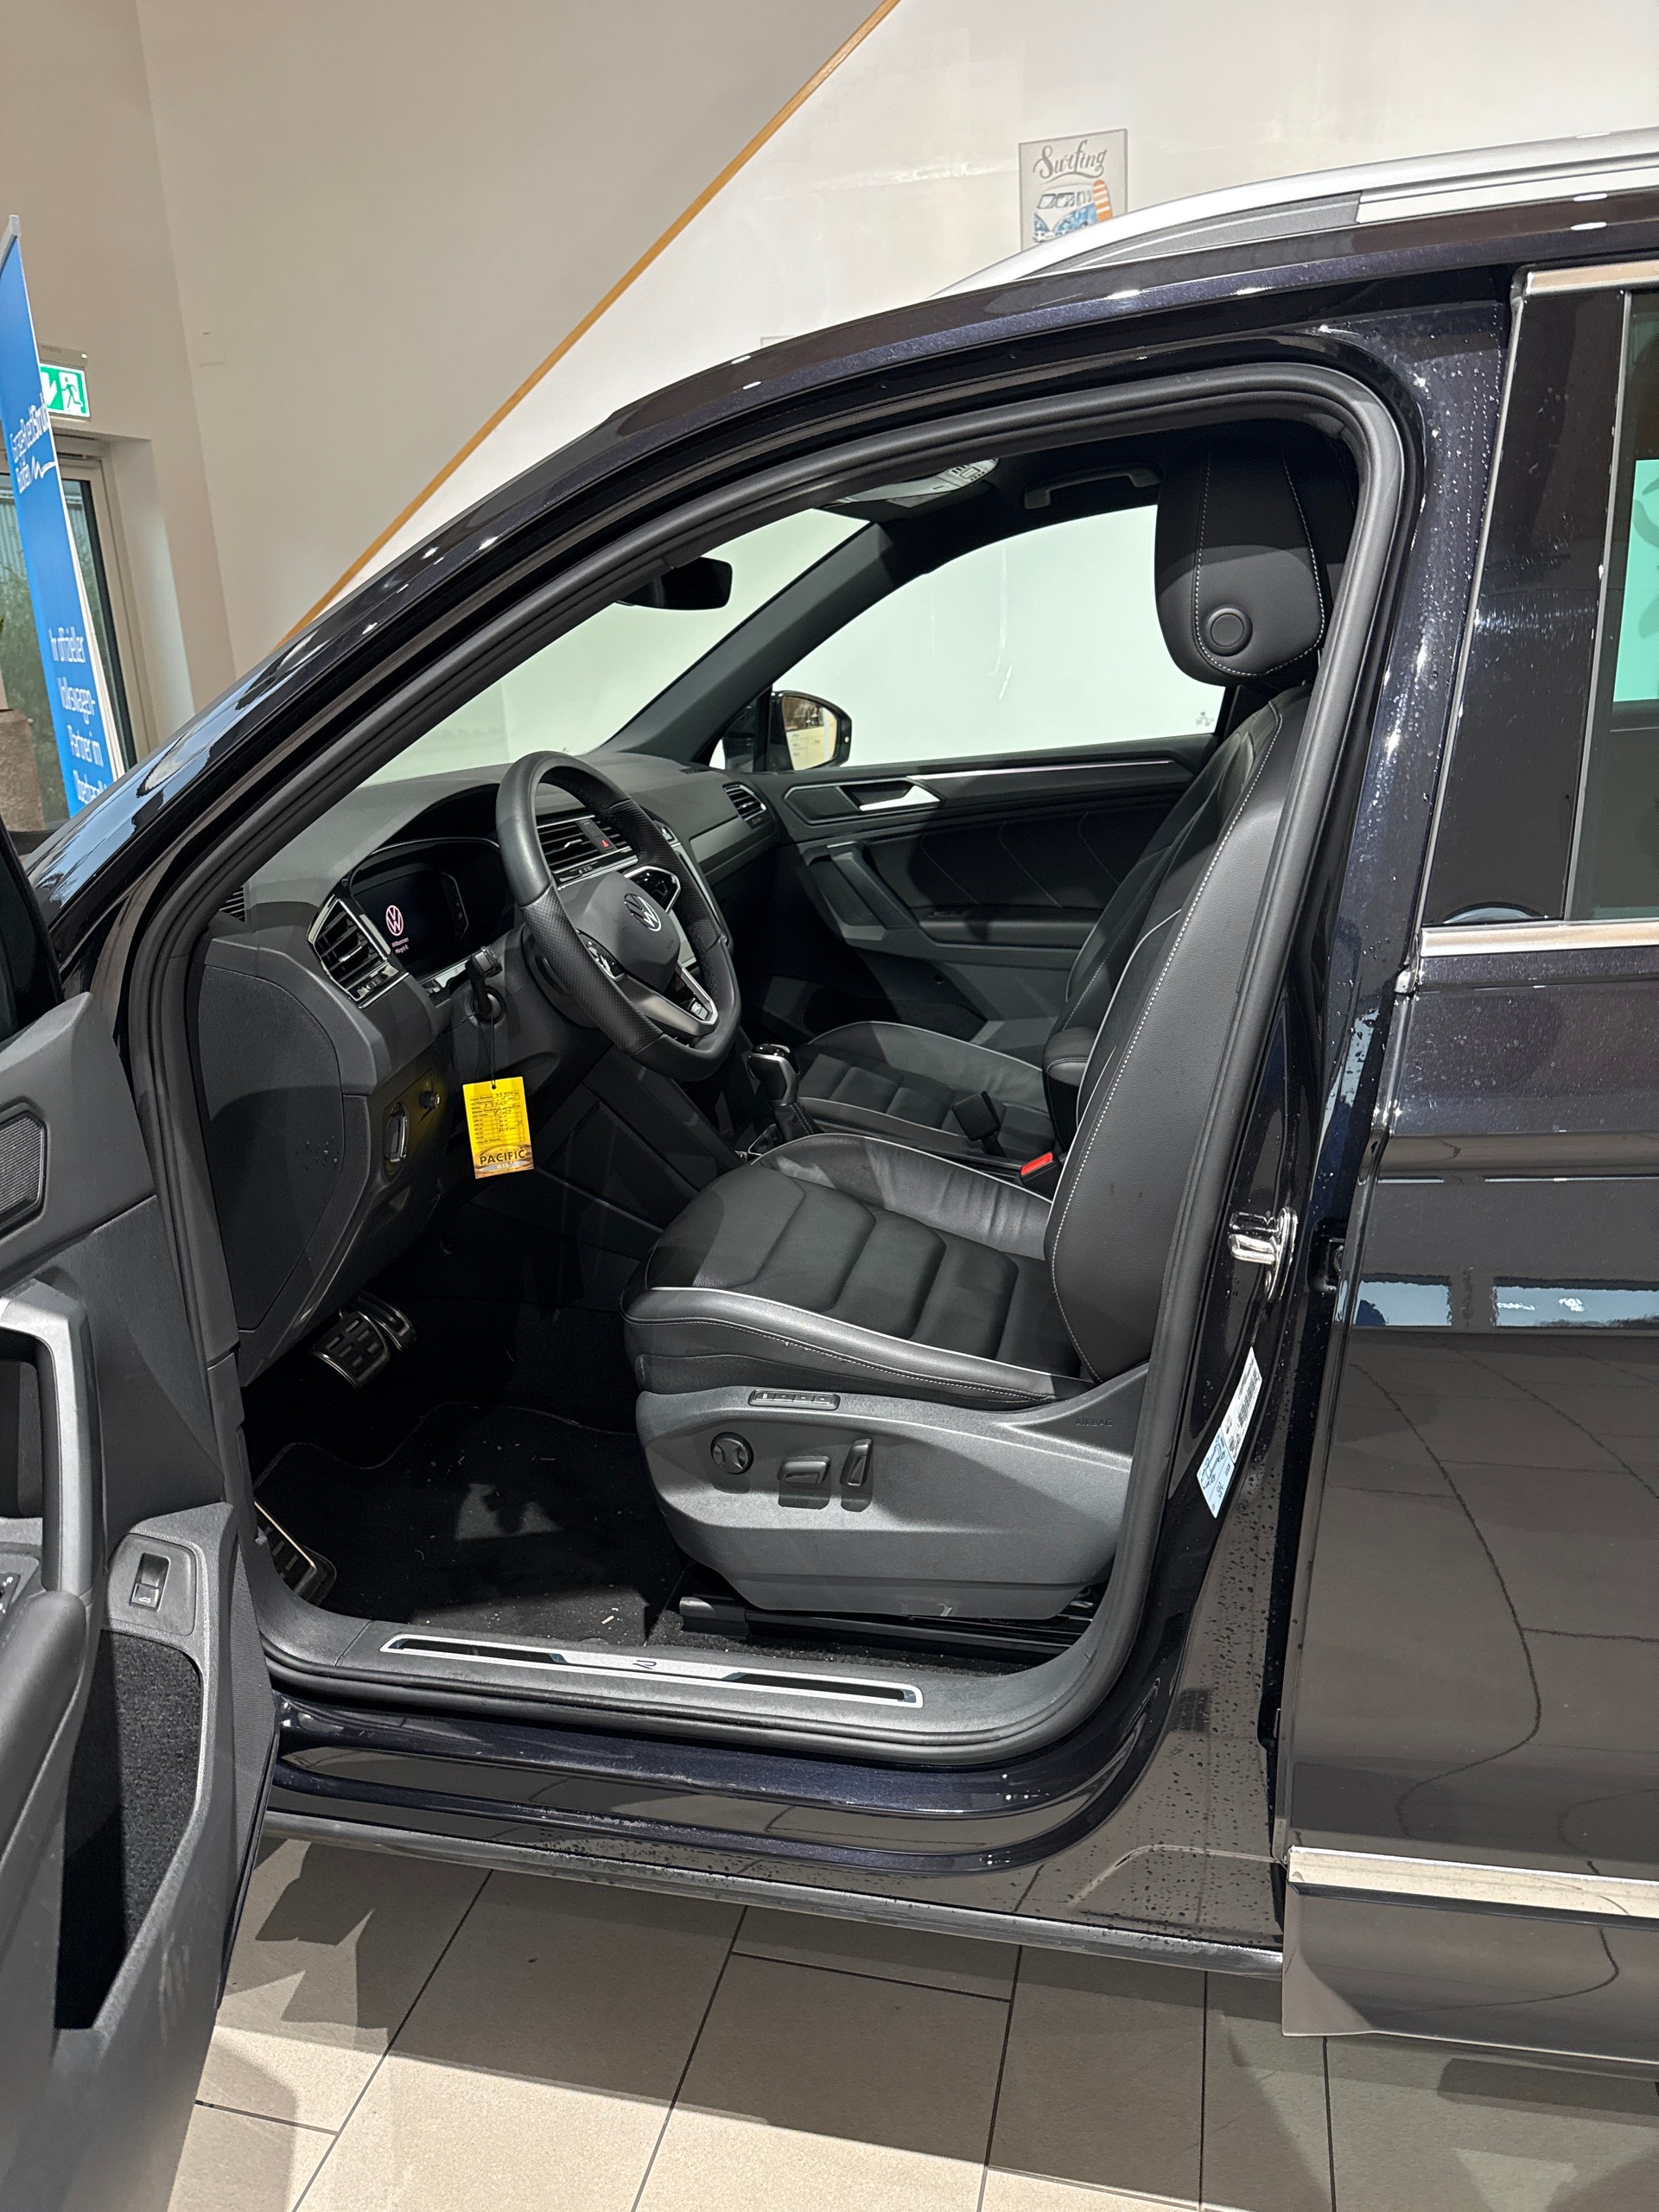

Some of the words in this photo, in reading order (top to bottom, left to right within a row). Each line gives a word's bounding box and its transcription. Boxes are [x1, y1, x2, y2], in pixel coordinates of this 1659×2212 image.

[1033, 139, 1107, 180] Surfing
[480, 1149, 525, 1165] PACIFIC
[1075, 1418, 1113, 1427] AIRBAG
